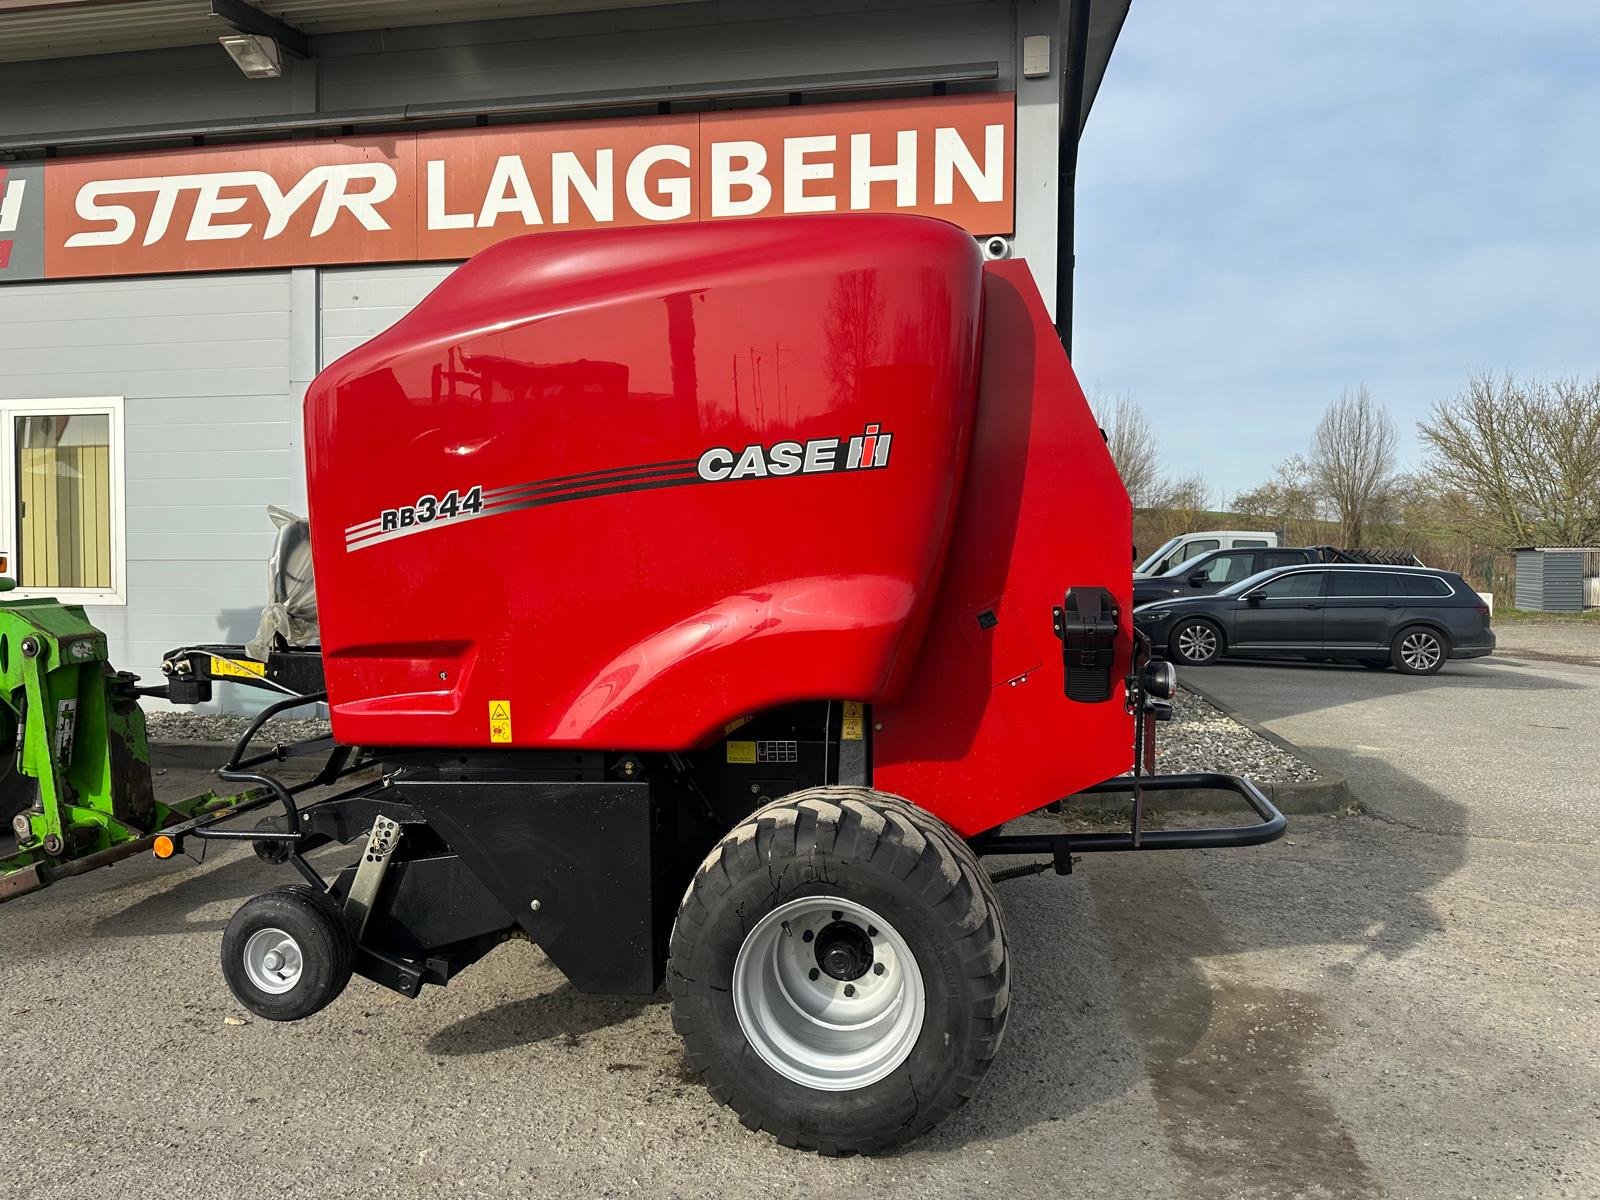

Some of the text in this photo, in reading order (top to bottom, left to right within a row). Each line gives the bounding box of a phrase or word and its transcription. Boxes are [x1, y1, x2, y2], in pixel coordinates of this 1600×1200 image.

[64, 162, 398, 248] STEYR
[427, 124, 1005, 230] LANGBEHN
[698, 438, 839, 481] CASE
[380, 485, 485, 532] RB344
